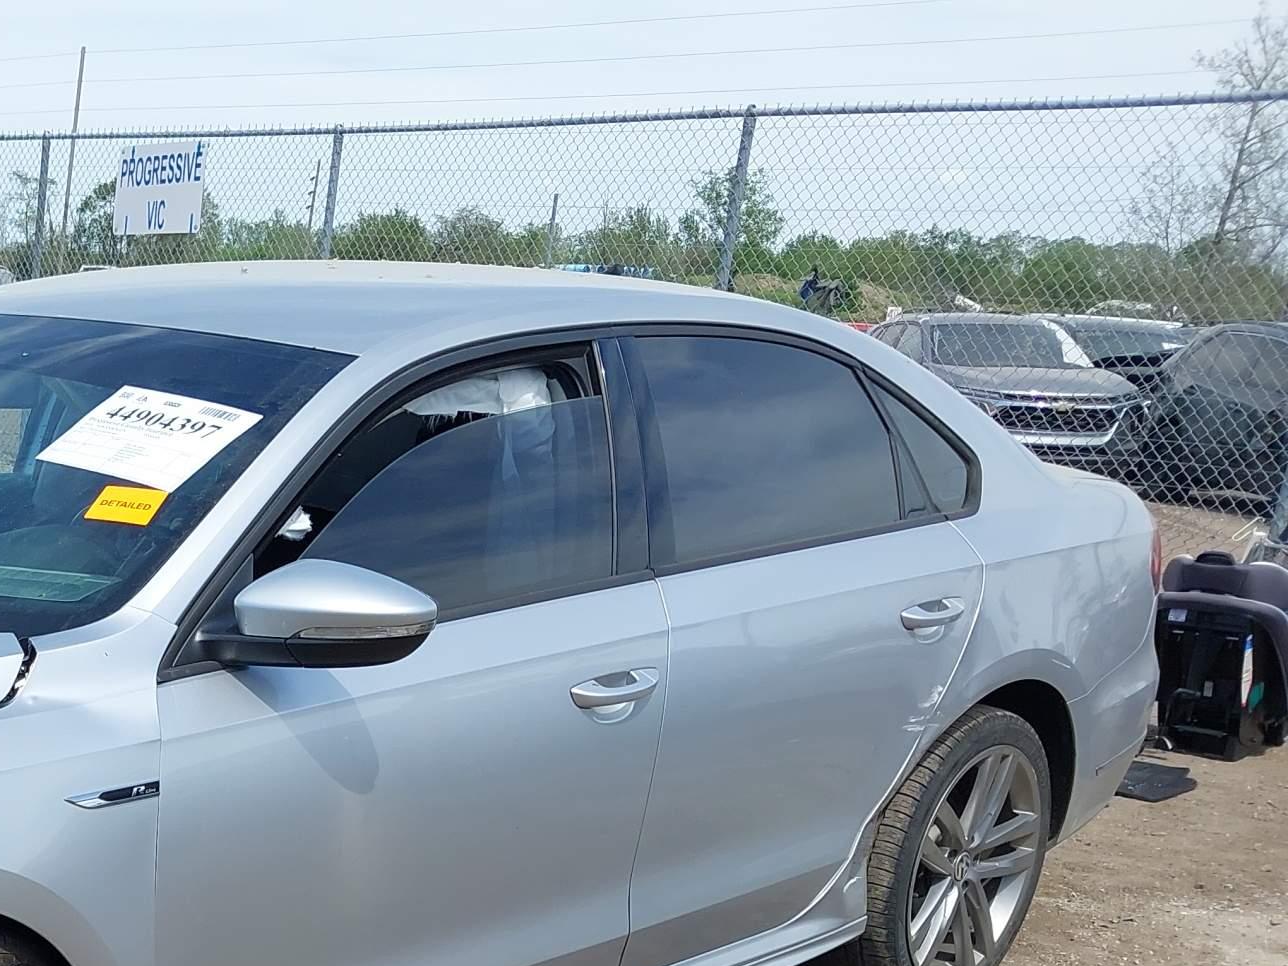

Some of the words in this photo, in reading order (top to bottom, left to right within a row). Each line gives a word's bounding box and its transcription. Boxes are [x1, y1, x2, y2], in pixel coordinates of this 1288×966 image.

[120, 150, 203, 188] PROGRESSIVE
[146, 199, 166, 231] VIC
[105, 405, 224, 439] 44904397
[98, 498, 153, 512] DETAILED
